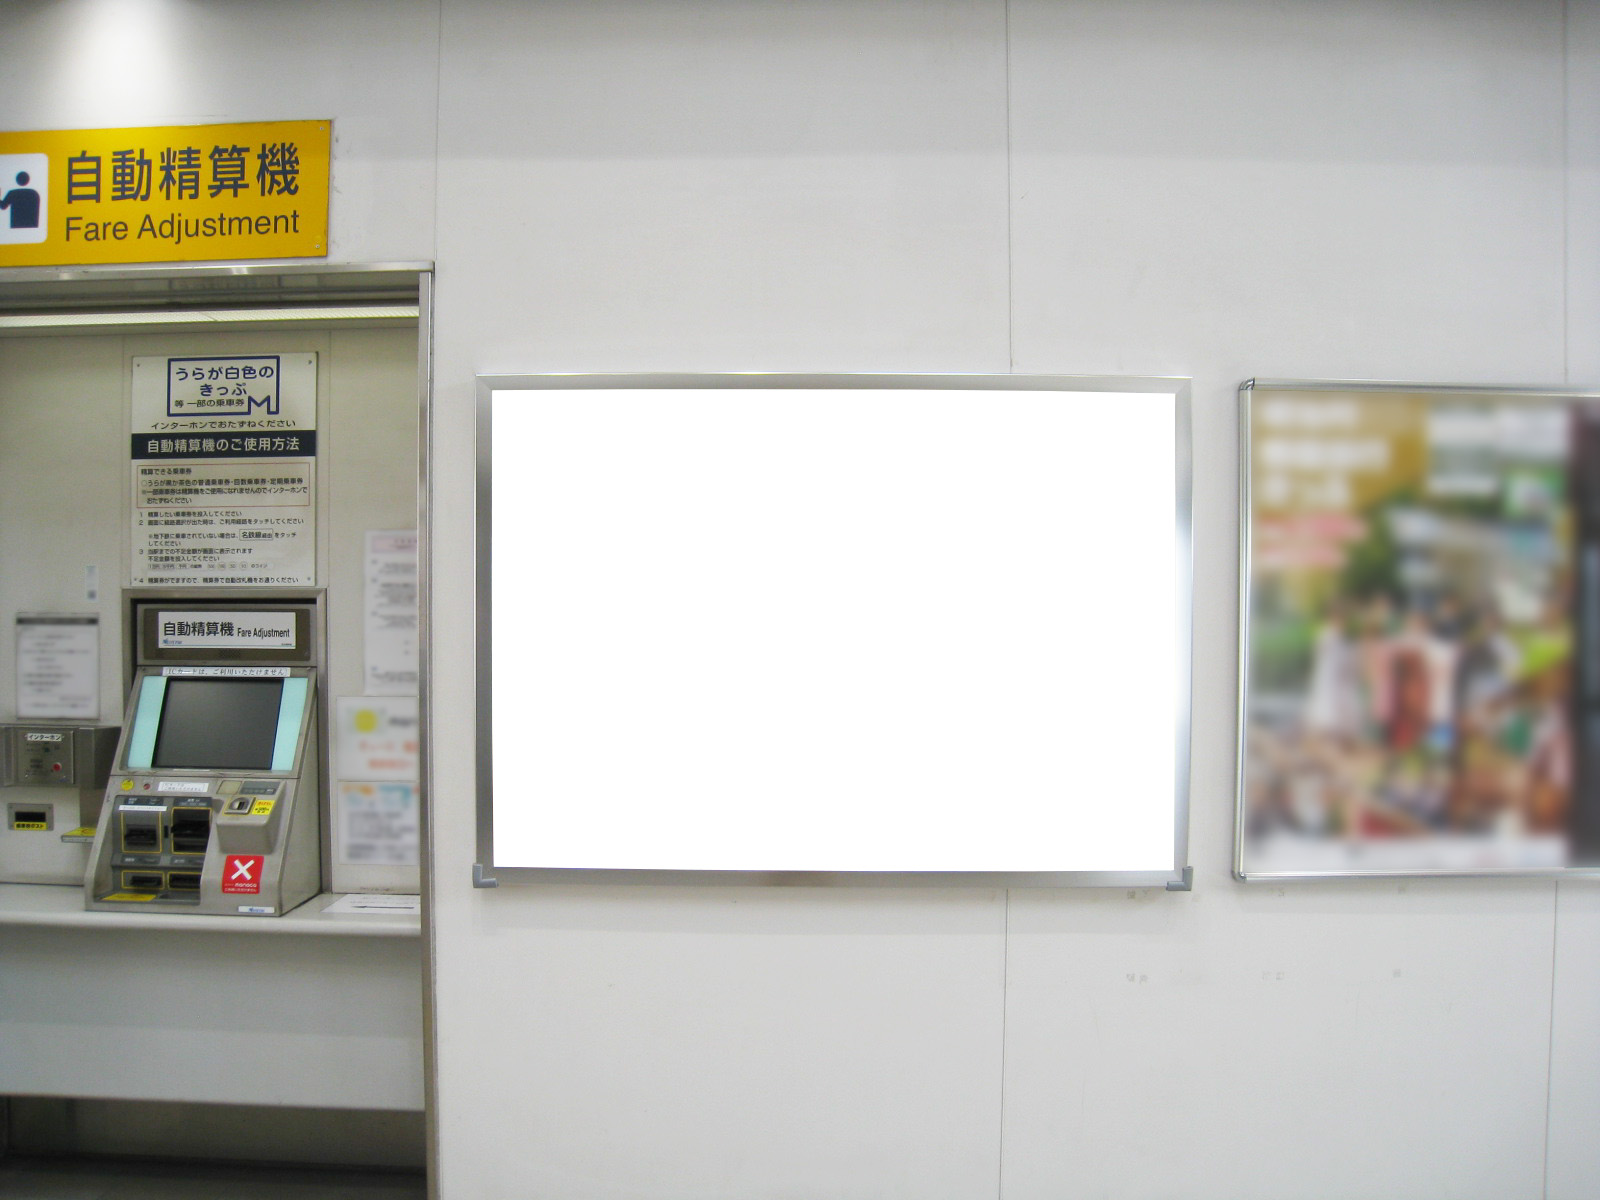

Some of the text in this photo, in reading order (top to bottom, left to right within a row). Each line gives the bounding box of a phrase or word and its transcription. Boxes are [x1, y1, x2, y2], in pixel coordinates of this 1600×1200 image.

[67, 142, 300, 204] 自動精算機
[66, 210, 299, 244] Fare Adjustment
[175, 365, 274, 381] うらが白色の
[199, 383, 248, 397] きっぷ
[151, 419, 296, 431] インターホンでおたずねください
[147, 437, 300, 454] 自動精算機のご使用方法
[163, 621, 290, 640] 自動精算機 Fare Adjustment
[28, 733, 61, 741] インターホン
